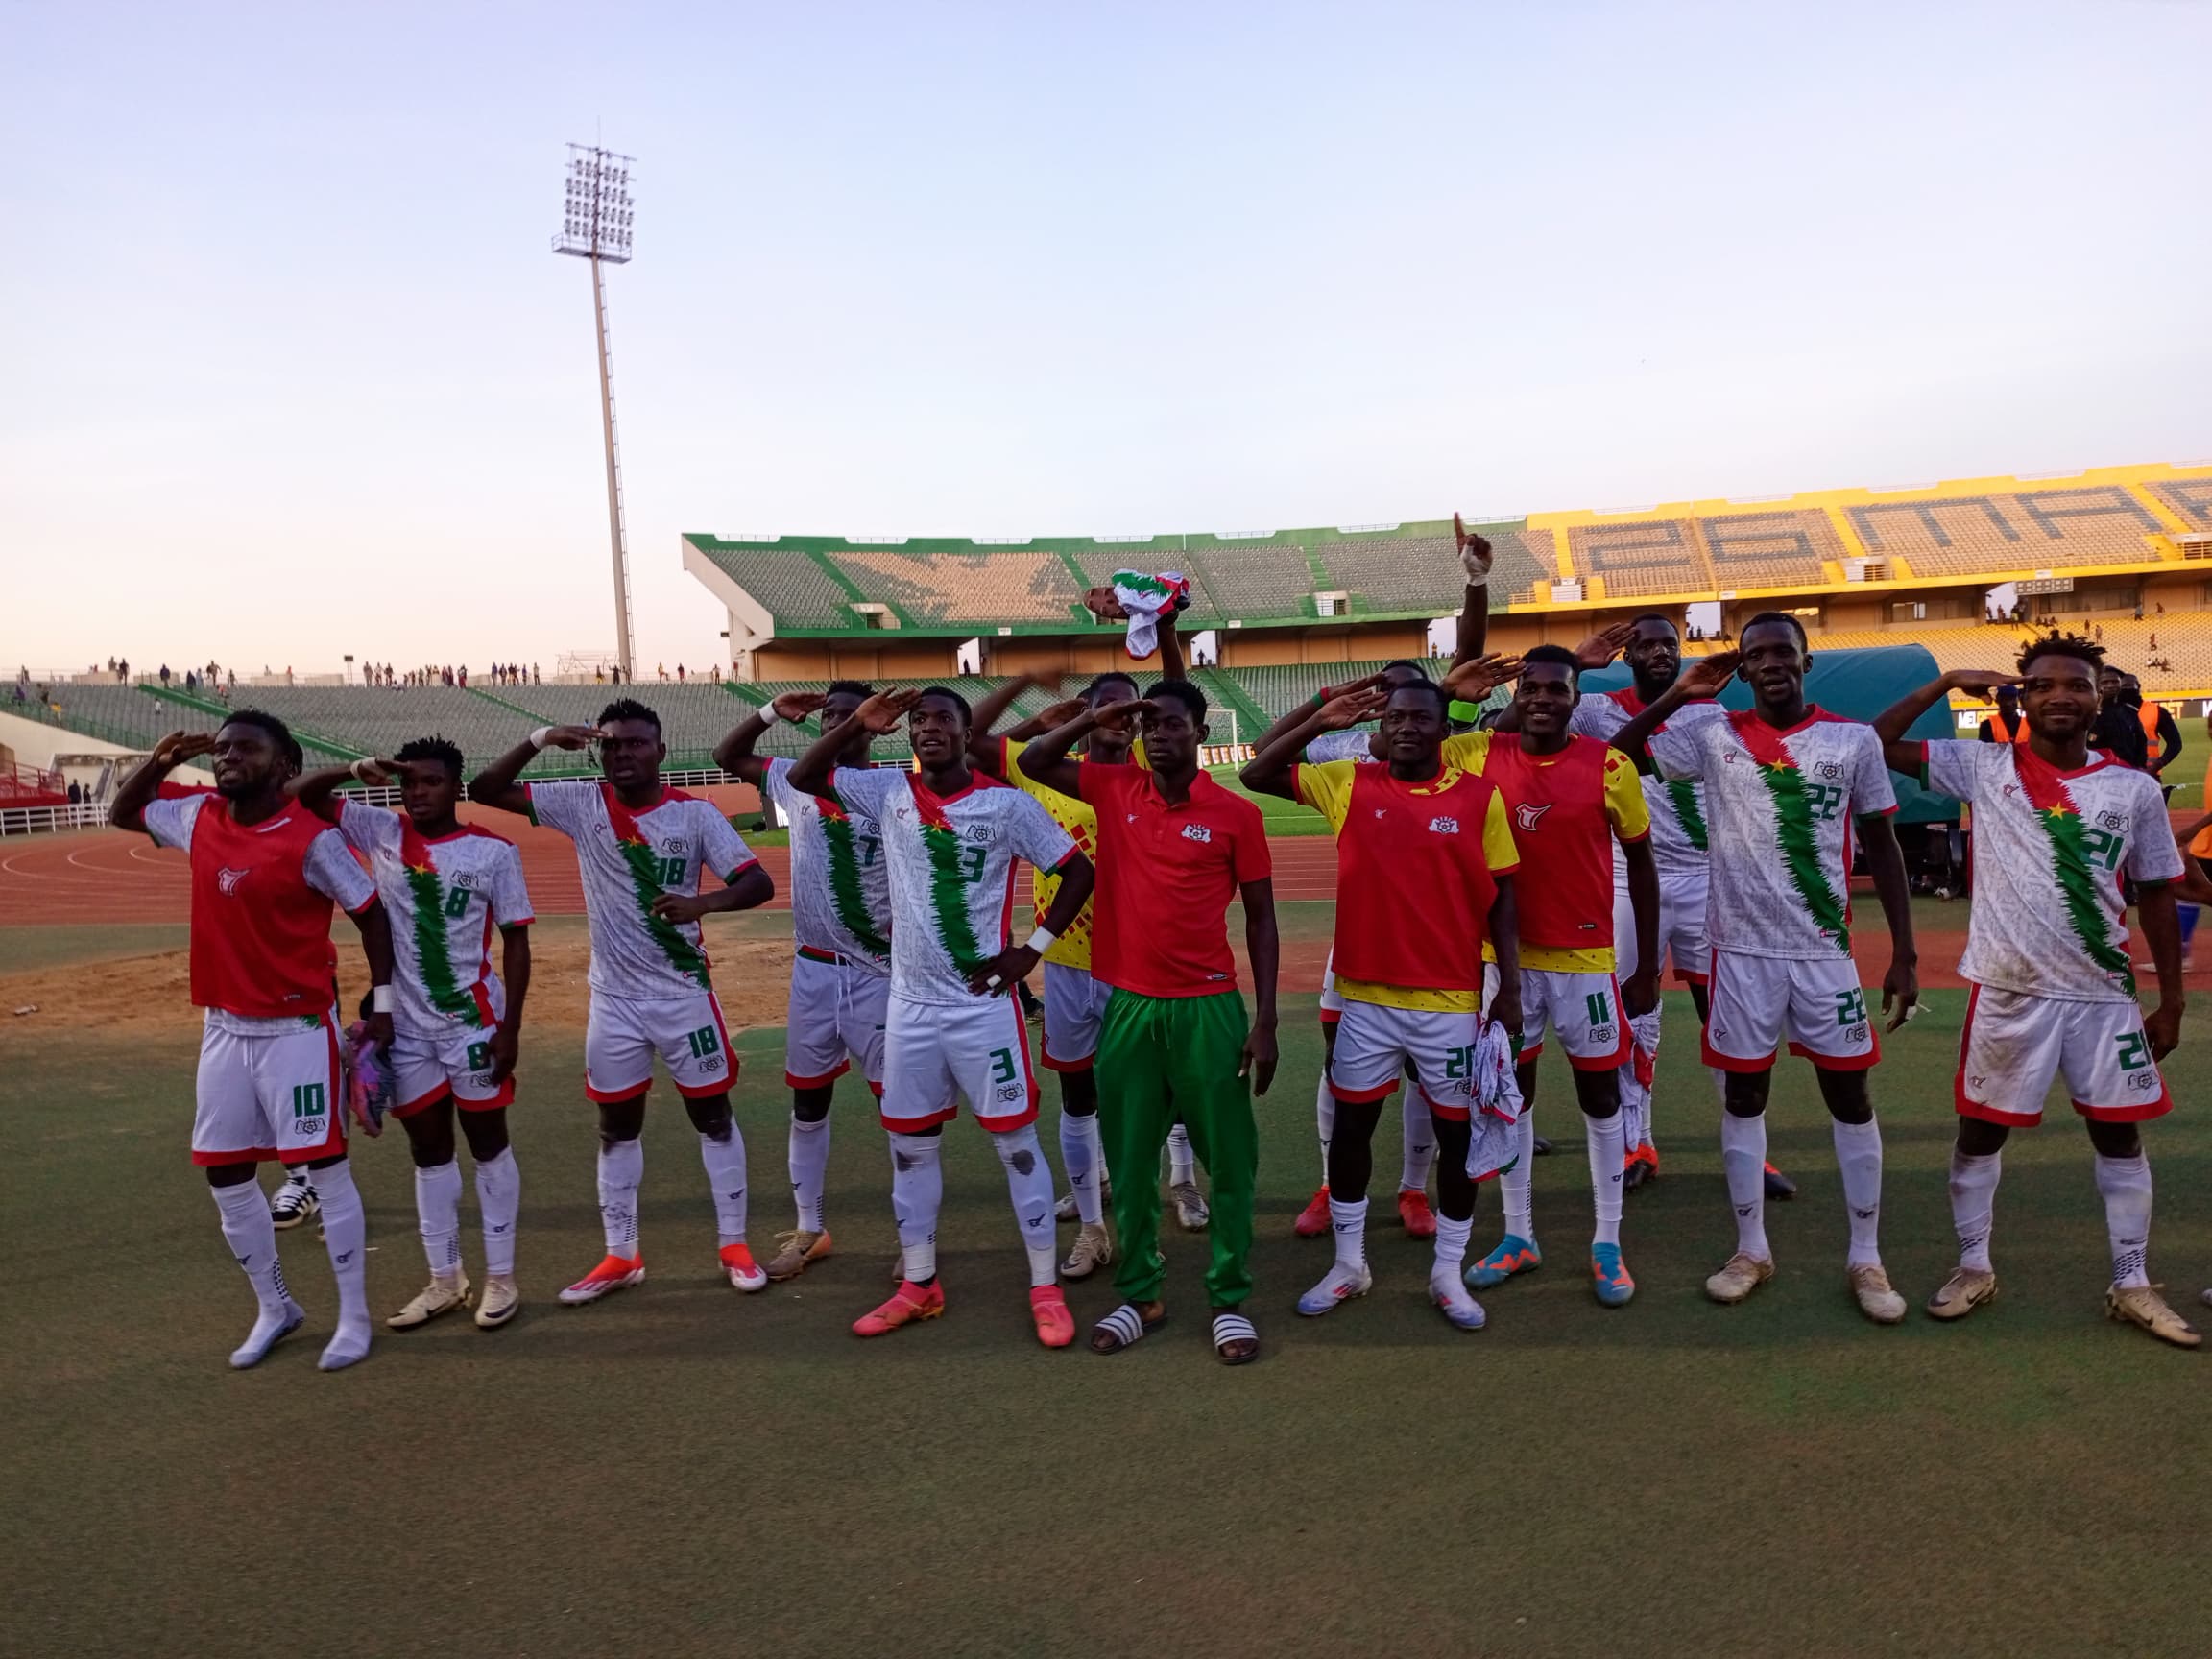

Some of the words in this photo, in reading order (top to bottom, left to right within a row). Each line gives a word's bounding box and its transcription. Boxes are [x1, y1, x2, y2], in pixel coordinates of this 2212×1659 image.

[1587, 511, 1815, 571] 26
[1804, 783, 1843, 821] 22
[859, 835, 878, 867] 7
[960, 846, 987, 883] 3
[2080, 829, 2125, 871] 21
[656, 857, 688, 885] 18
[445, 886, 471, 918] 8
[1586, 991, 1610, 1026] 11
[687, 1024, 720, 1059] 18
[989, 1047, 1017, 1085] 3
[293, 1082, 325, 1118] 10
